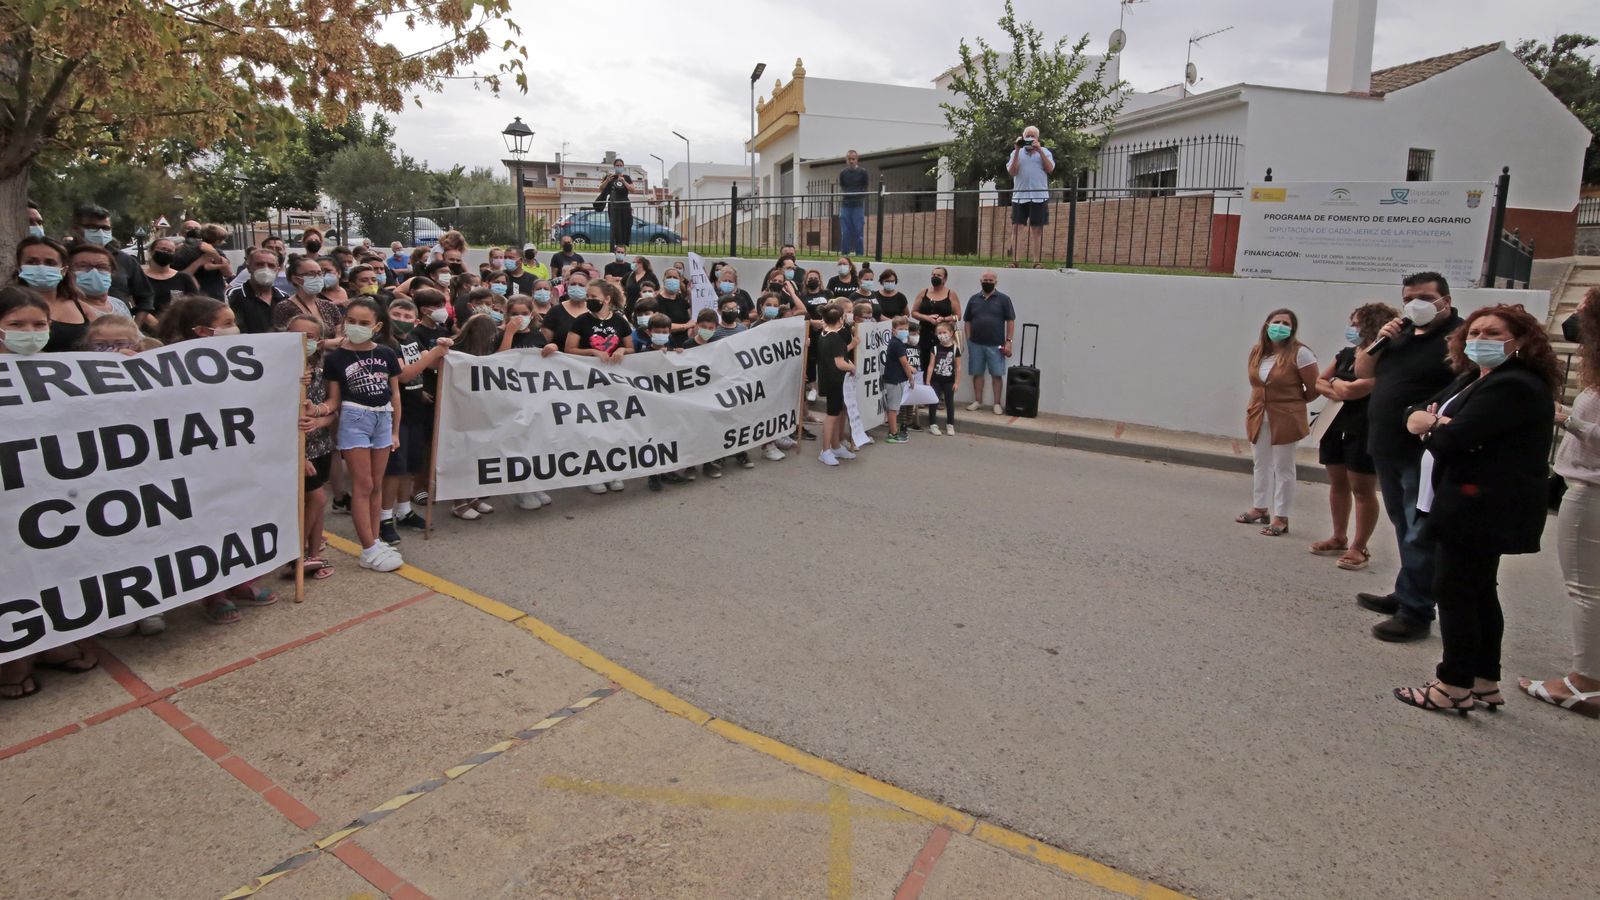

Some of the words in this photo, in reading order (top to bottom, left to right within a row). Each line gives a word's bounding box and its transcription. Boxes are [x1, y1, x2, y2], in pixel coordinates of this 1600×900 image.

[1264, 213, 1312, 221] PROGRAMA
[1328, 214, 1370, 222] FOMENTO
[1372, 215, 1385, 223] DE
[1387, 215, 1425, 224] EMPLEO
[1427, 216, 1471, 224] AGRARIO
[1406, 229, 1452, 237] FRONTERA
[1243, 249, 1301, 258] FINANCIACIÓN:
[358, 357, 388, 367] ROMA
[735, 337, 802, 371] DIGNAS
[470, 364, 711, 394] INSTALACIONES
[715, 380, 766, 409] UNA
[552, 394, 646, 426] PARA
[723, 408, 797, 449] SEGURA
[478, 438, 679, 485] EDUCACIÓN
[18, 477, 193, 550] CON
[0, 522, 279, 653] GURIDAD
